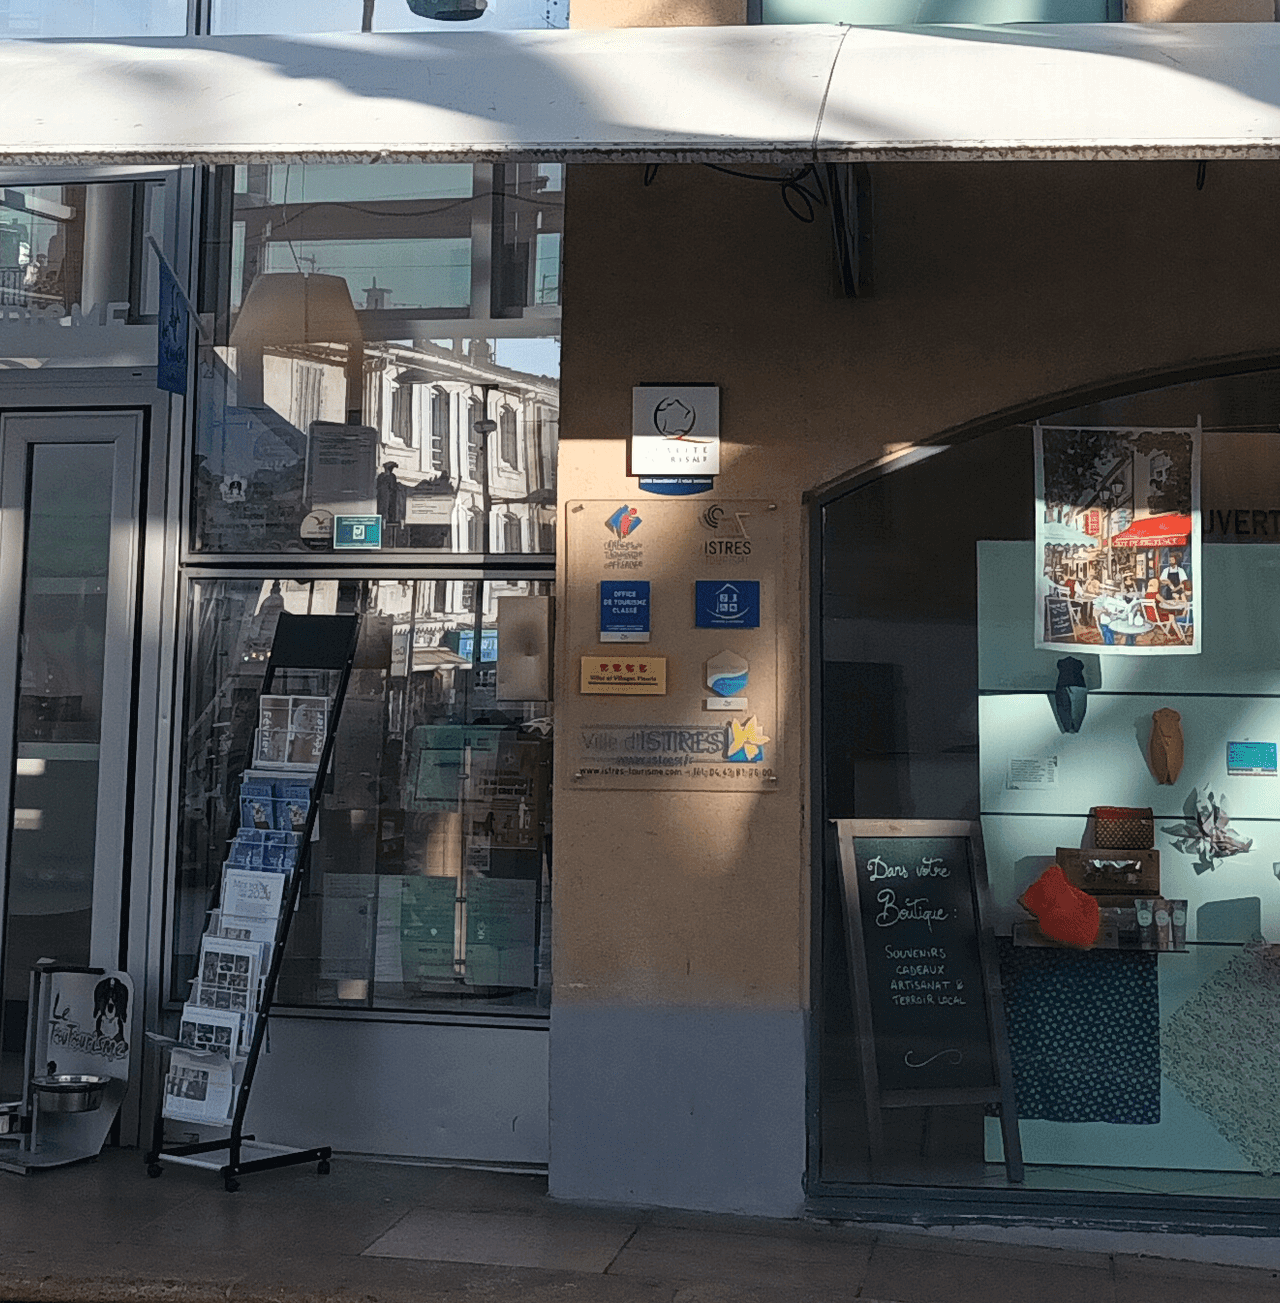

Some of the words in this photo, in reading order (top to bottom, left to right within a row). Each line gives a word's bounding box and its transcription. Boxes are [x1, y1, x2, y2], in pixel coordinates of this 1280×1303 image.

[704, 541, 752, 555] ISTRES
[867, 855, 908, 881] Dans
[916, 857, 951, 877] votre
[885, 945, 946, 959] SOUVENIRS
[896, 965, 945, 976] CADEAUX
[890, 980, 951, 991] ARTISANAT
[53, 991, 71, 1021] Le
[937, 995, 966, 1006] LOCAL
